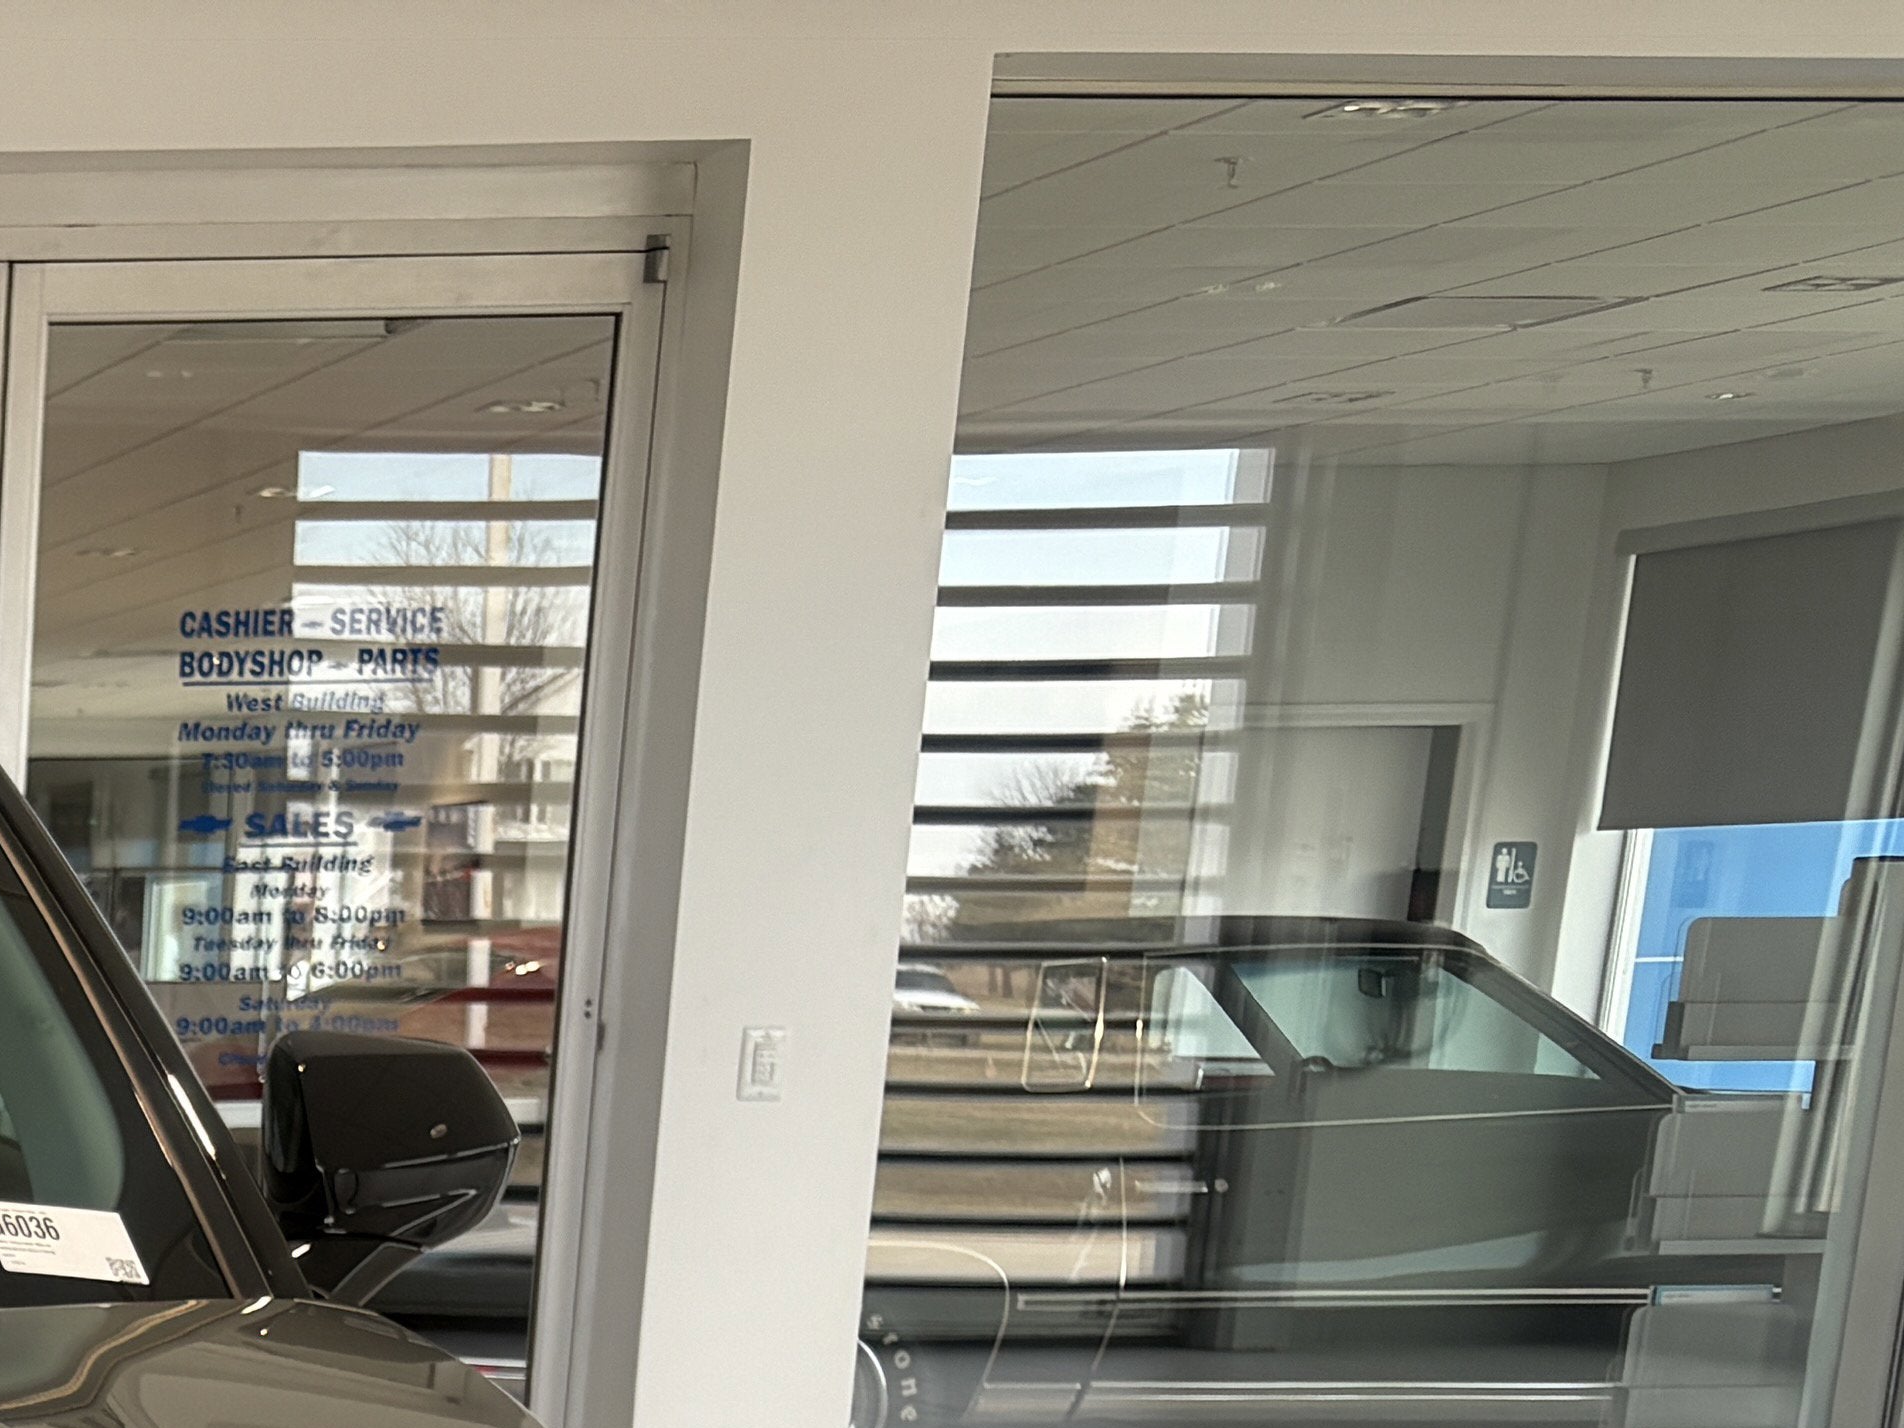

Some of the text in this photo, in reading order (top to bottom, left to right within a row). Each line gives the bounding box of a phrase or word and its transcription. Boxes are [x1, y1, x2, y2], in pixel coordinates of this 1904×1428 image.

[180, 607, 444, 639] CASHIER SERVICE
[179, 648, 439, 679] BODYSHOP PARTS
[226, 691, 384, 715] West Building
[178, 718, 420, 745] Monday thru Friday
[292, 752, 312, 768] to
[321, 750, 403, 771] 5:00pm
[245, 811, 355, 840] SALES
[223, 853, 374, 877] East Building
[250, 883, 330, 901] Monday
[182, 907, 272, 926] 9:00am
[178, 963, 268, 982] 9:00am
[311, 960, 401, 981] 6:00pm
[176, 1017, 266, 1036] 9:00am
